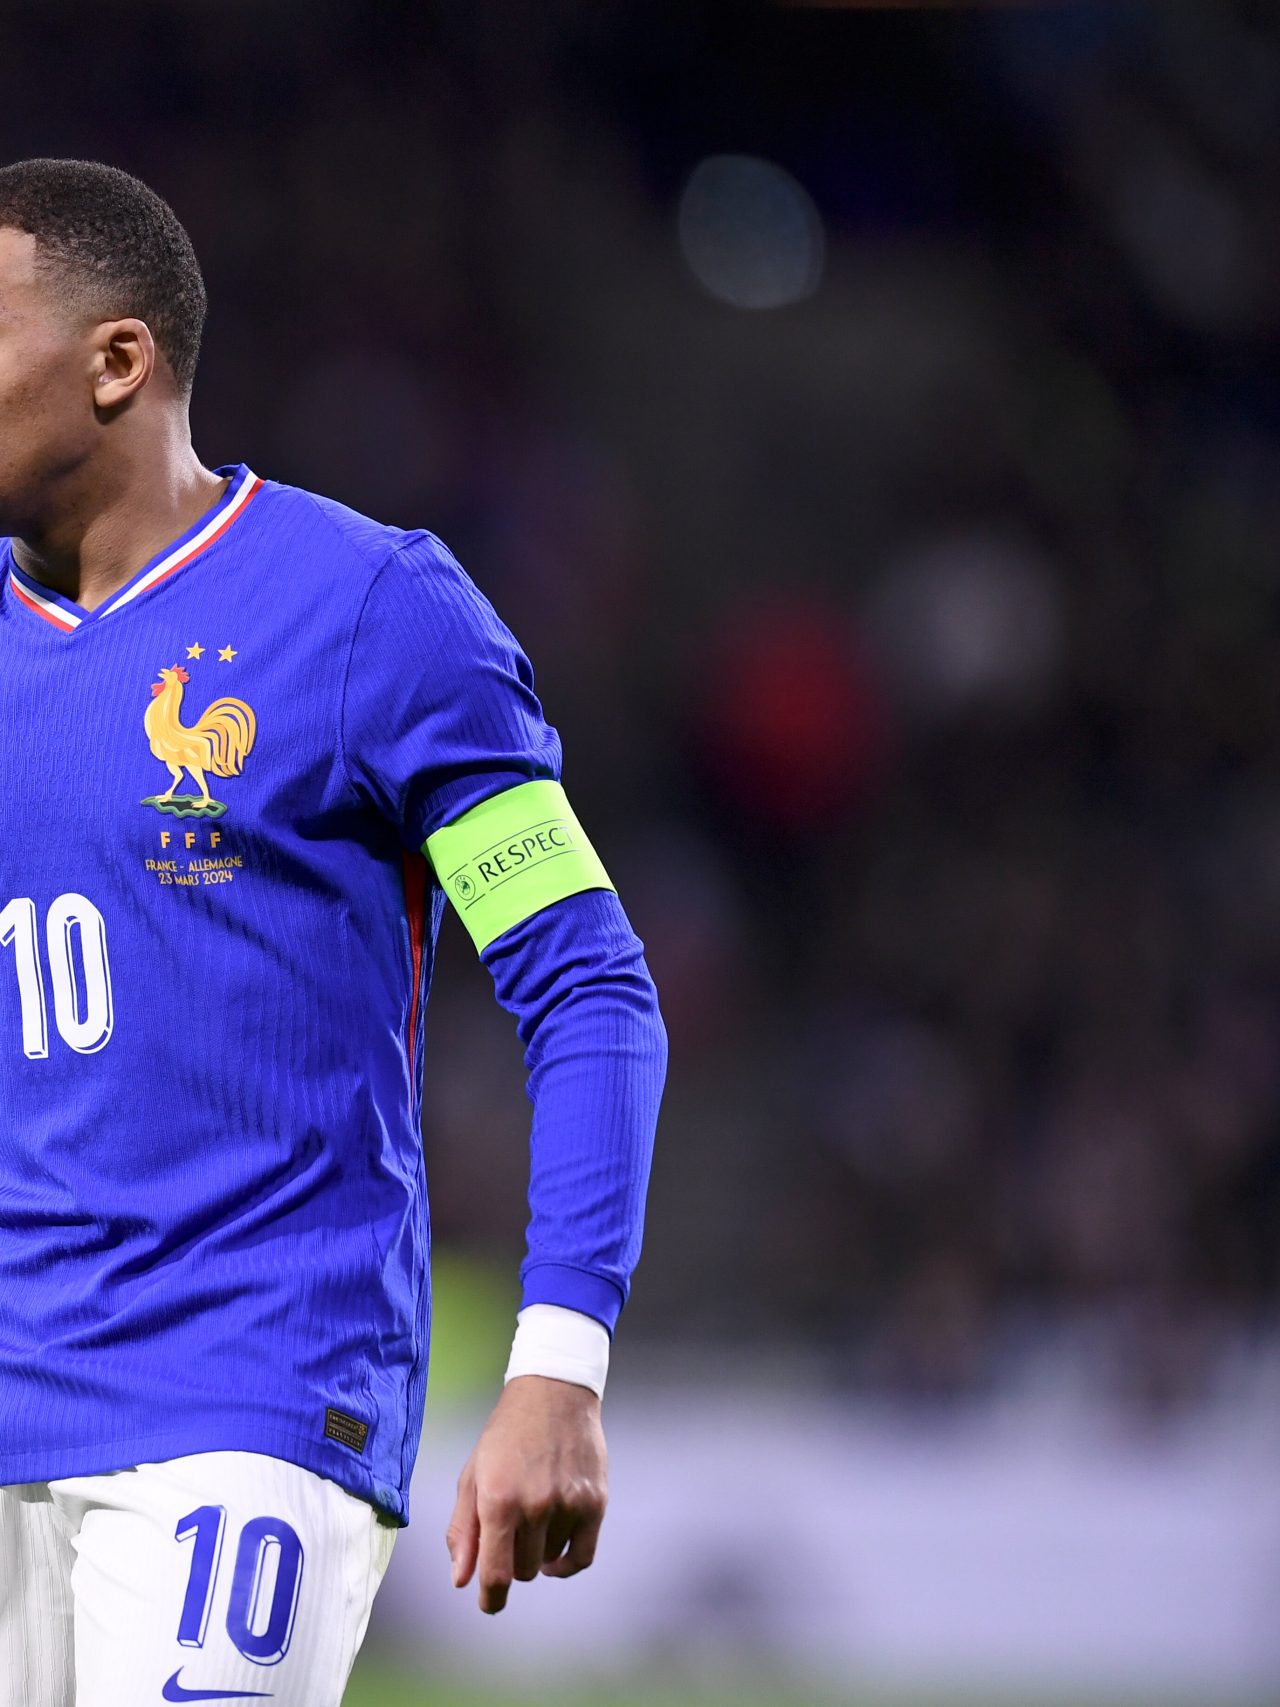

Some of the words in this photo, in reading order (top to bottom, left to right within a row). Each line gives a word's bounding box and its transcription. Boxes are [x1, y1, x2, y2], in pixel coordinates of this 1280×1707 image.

[145, 859, 178, 872] FRANCE
[188, 856, 243, 872] ALLEMAGNE
[158, 872, 173, 885] 23
[174, 873, 200, 886] MARS
[202, 870, 233, 885] 2024
[174, 1504, 305, 1667] 10
